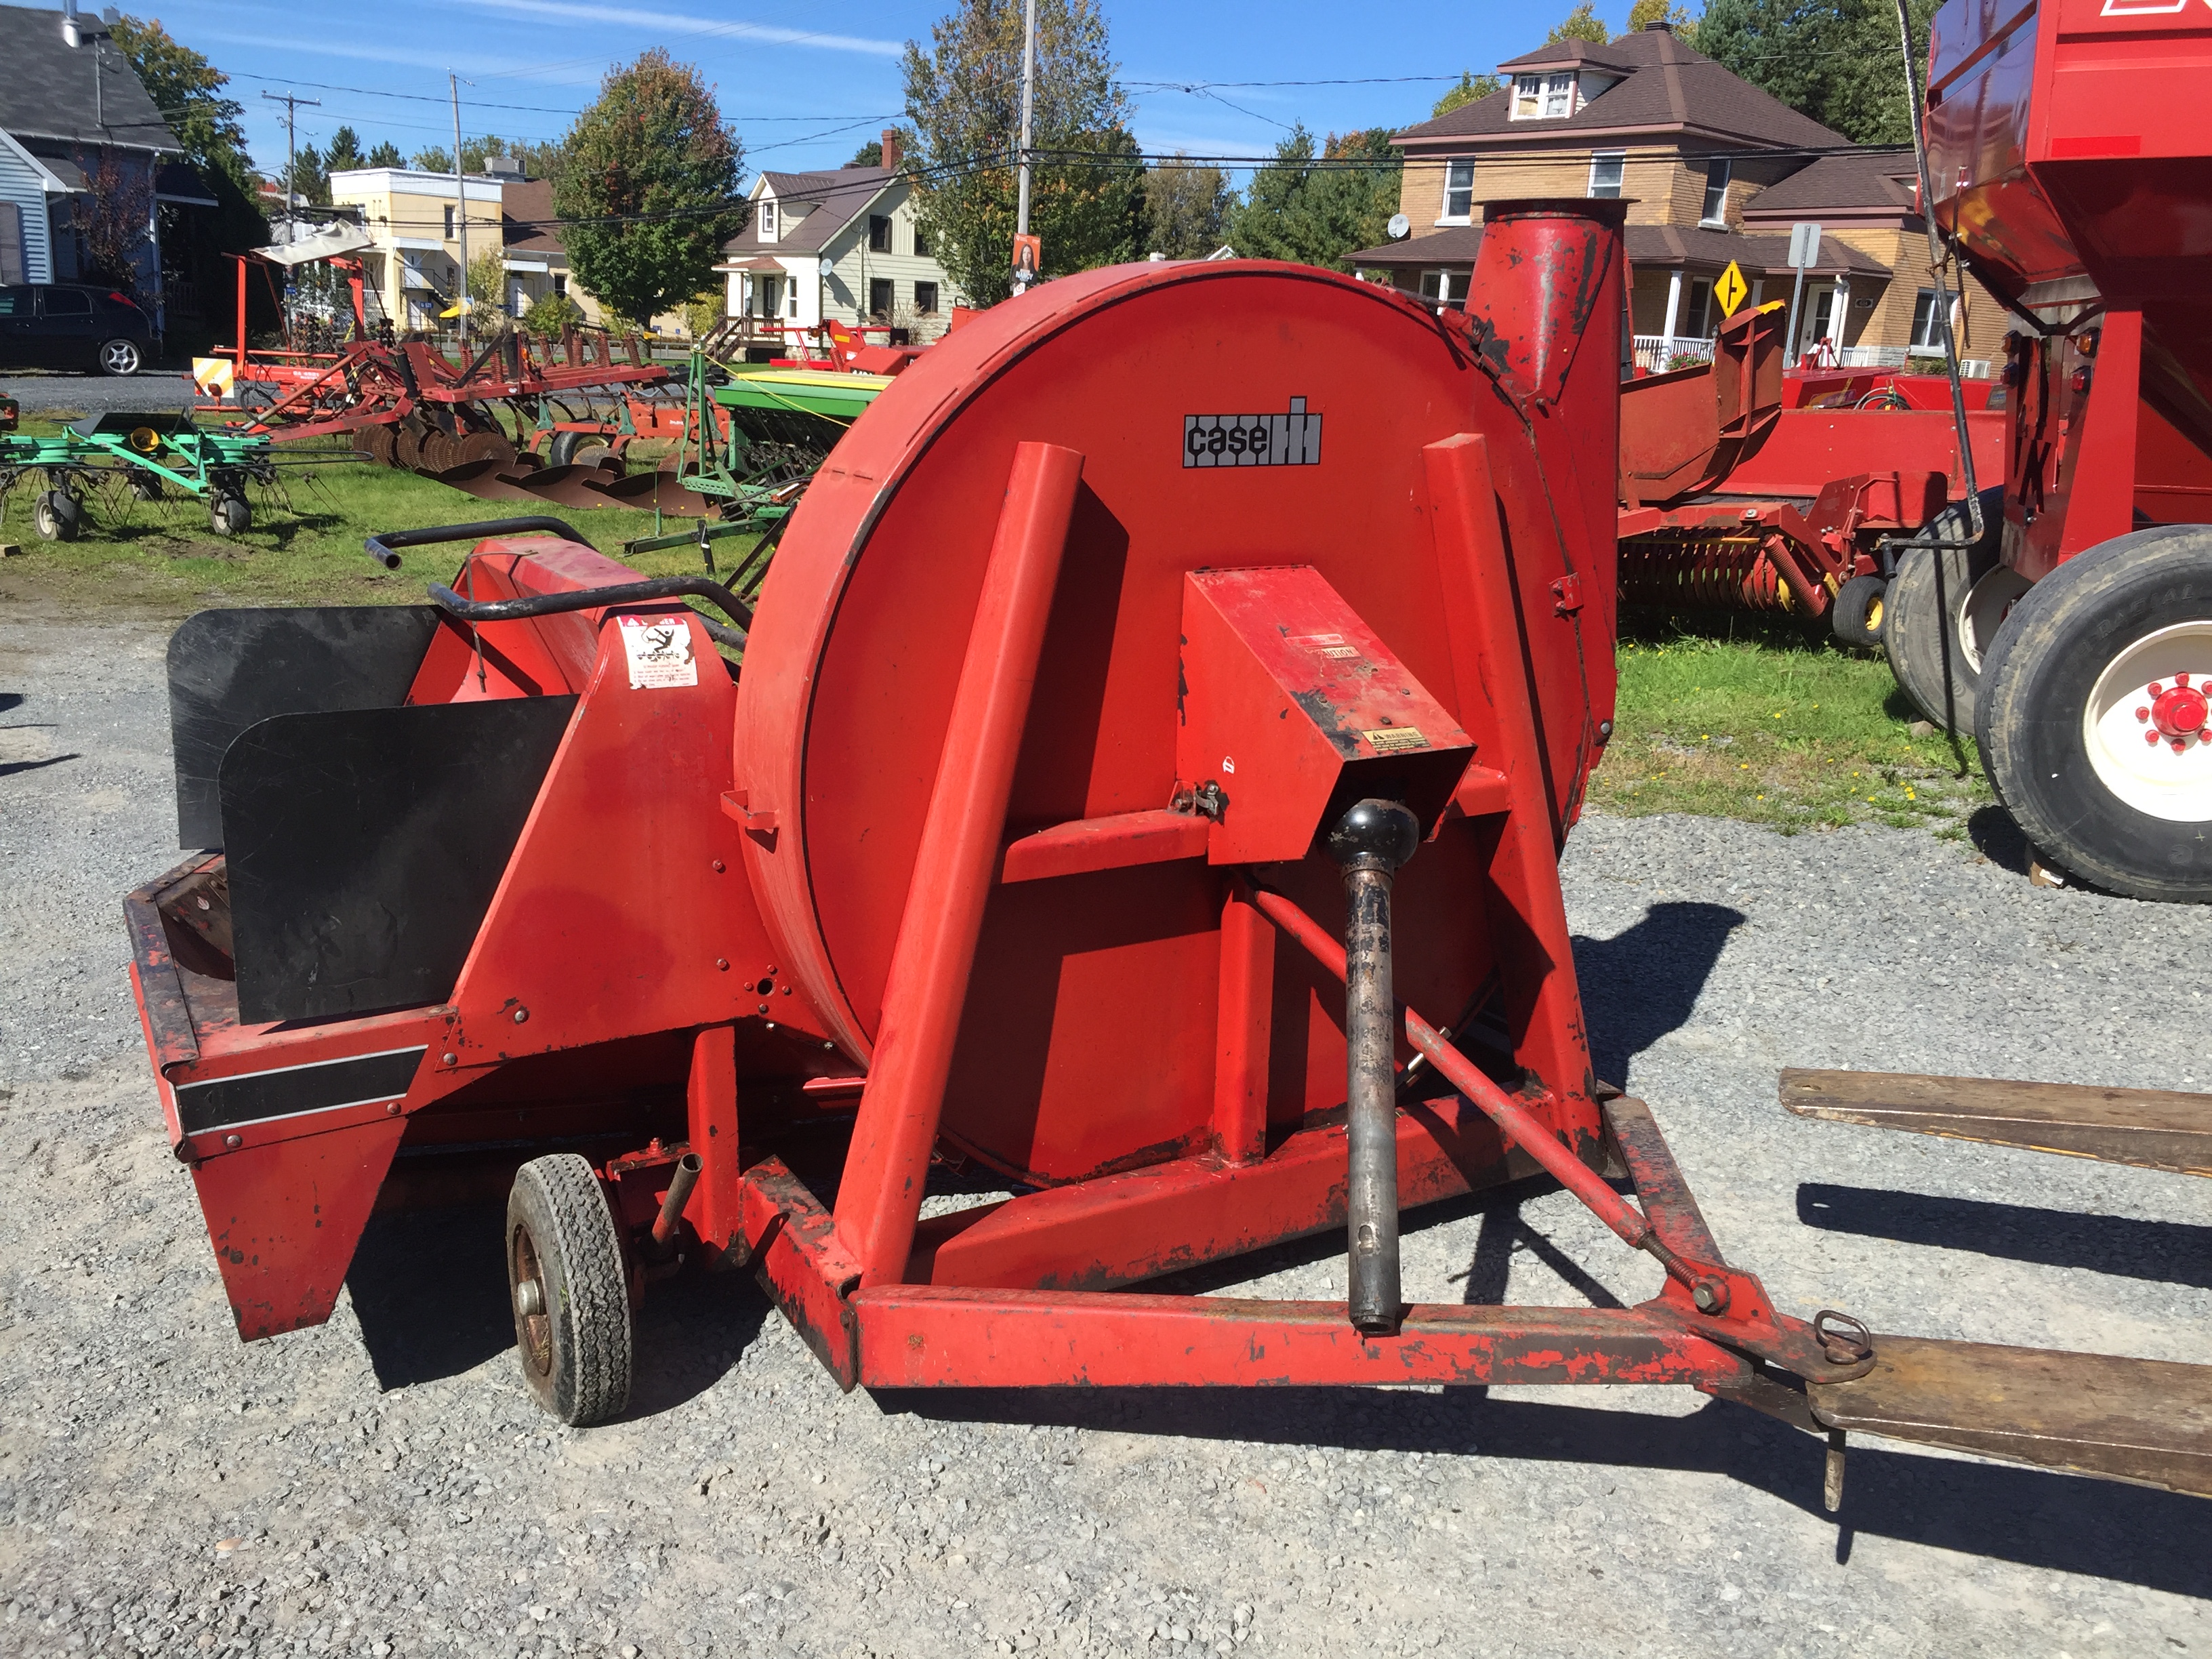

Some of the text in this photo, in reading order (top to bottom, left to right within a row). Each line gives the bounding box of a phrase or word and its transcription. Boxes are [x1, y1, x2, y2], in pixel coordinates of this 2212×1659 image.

[1015, 270, 1034, 281] NANCY
[1322, 648, 1354, 658] AUTION
[1384, 731, 1419, 739] WARNING
